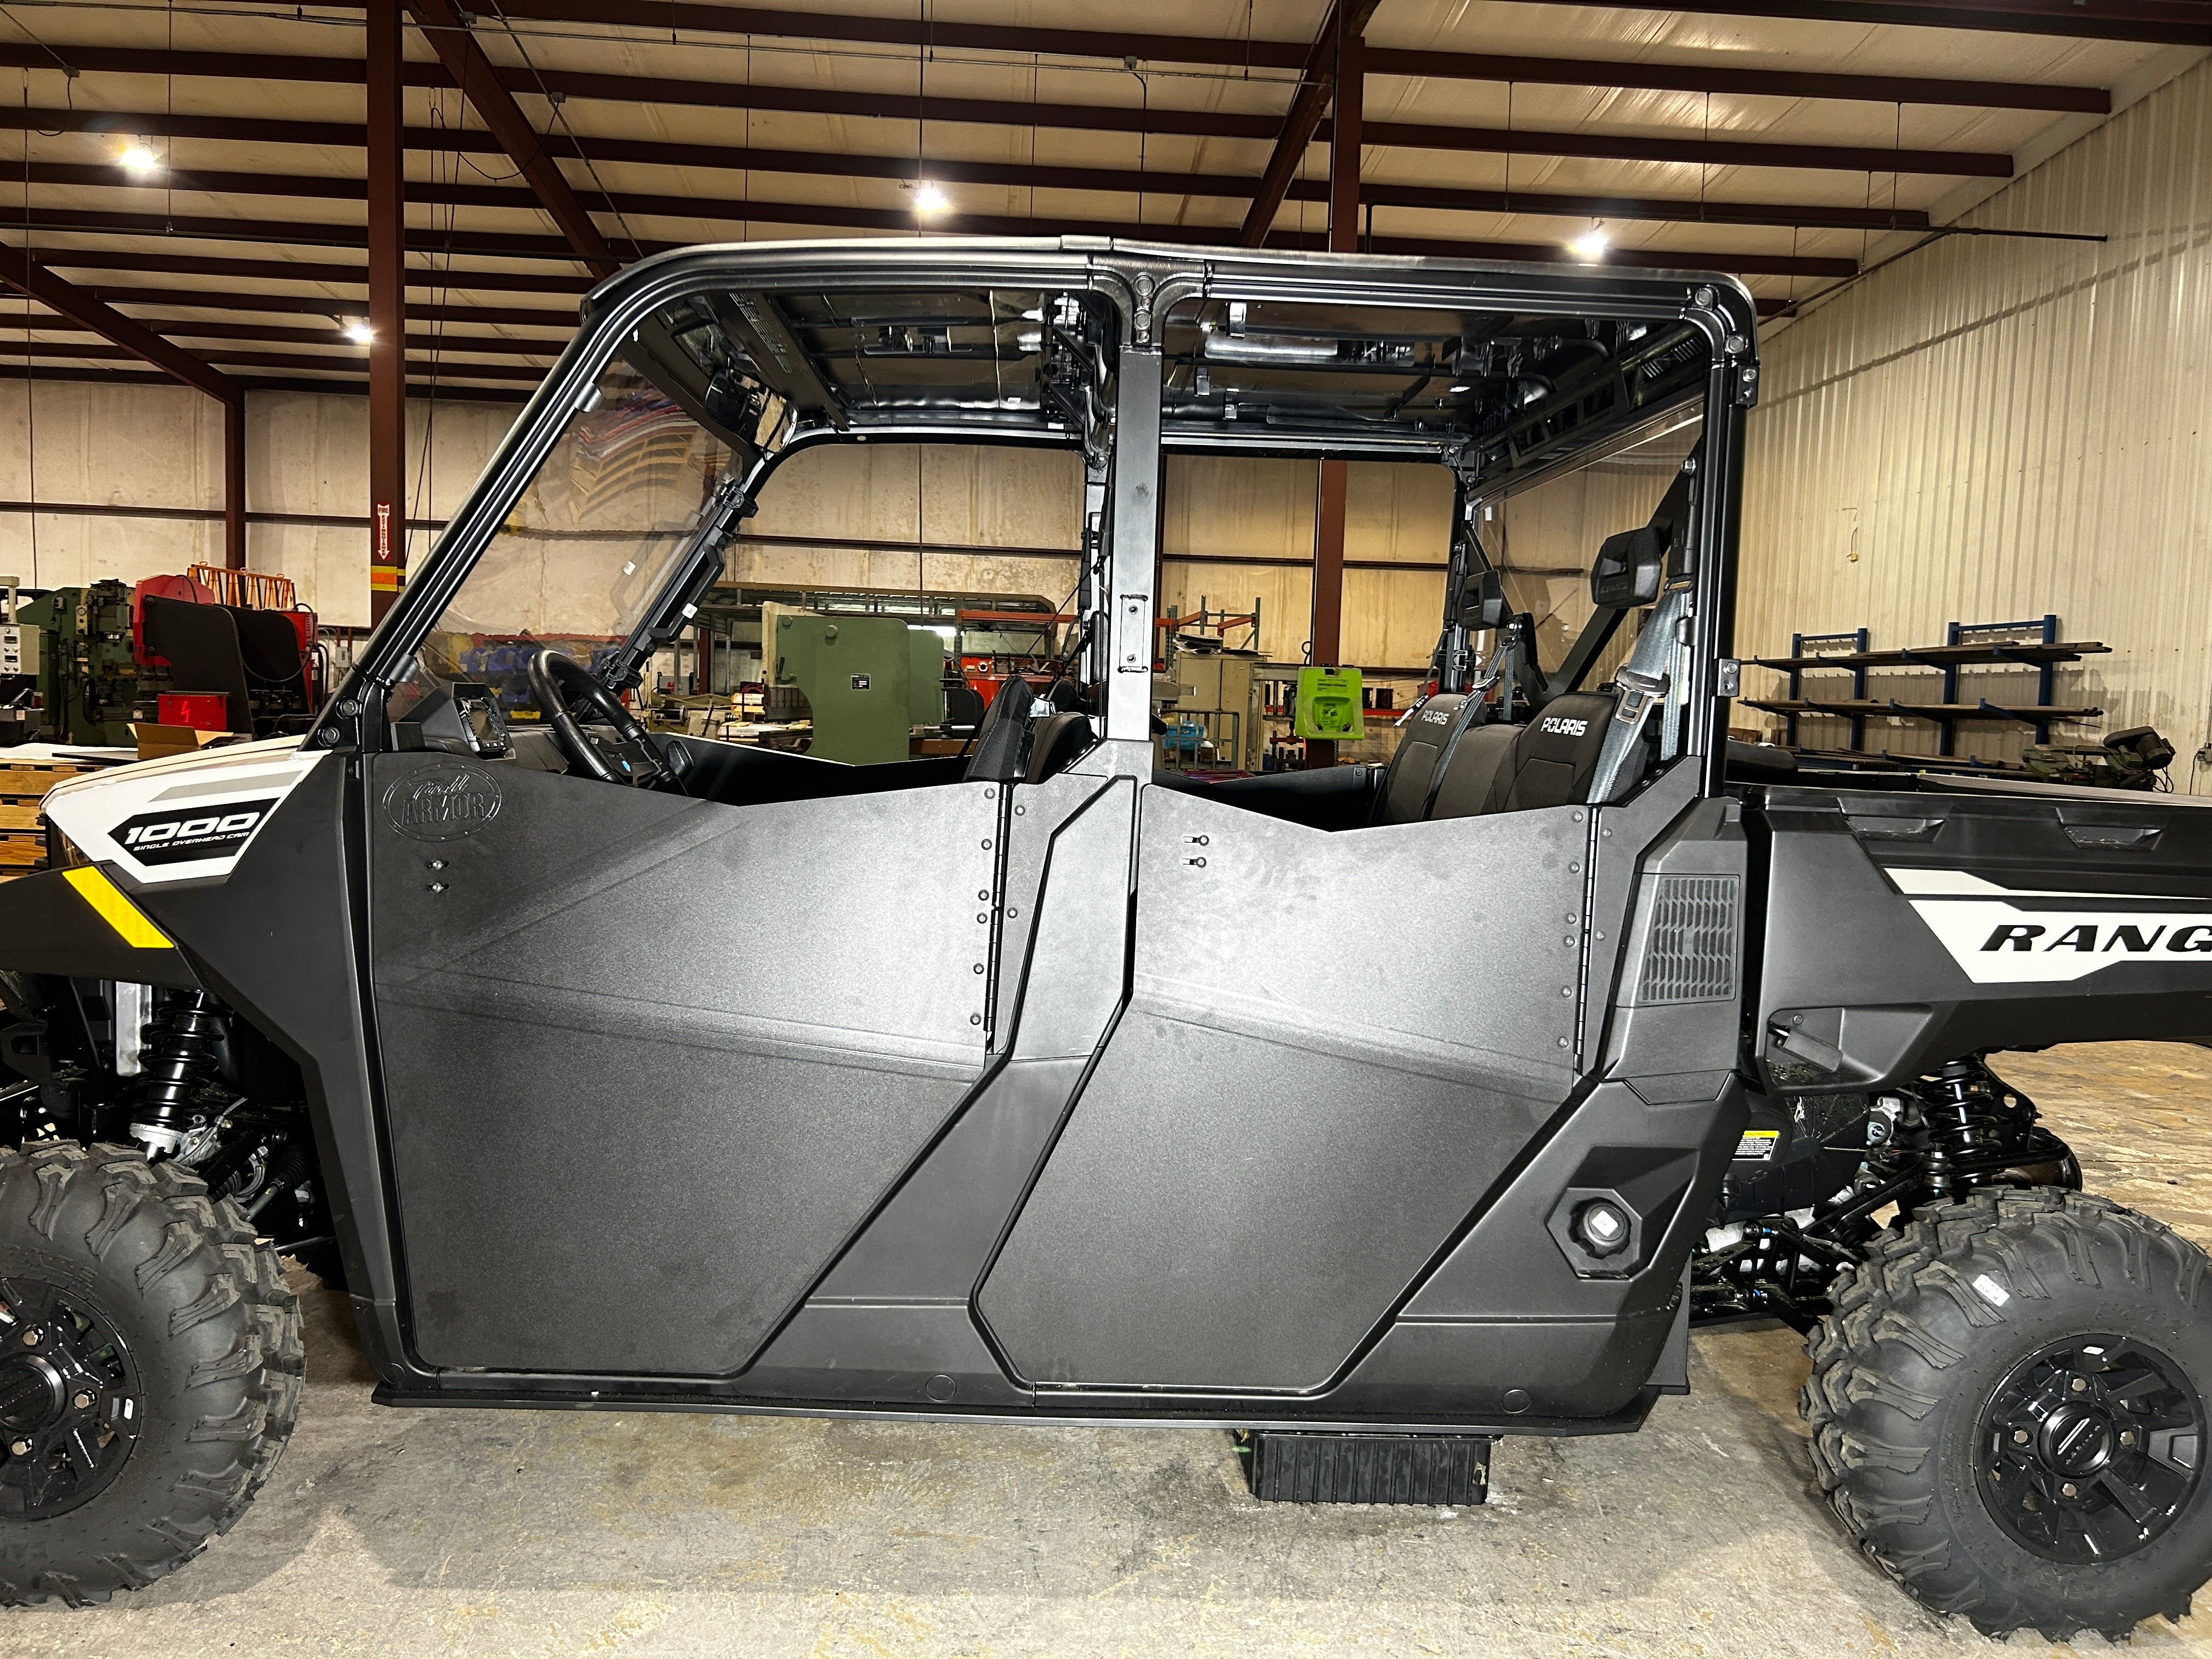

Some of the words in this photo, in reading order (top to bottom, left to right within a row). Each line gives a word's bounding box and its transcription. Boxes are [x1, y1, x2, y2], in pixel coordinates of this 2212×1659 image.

[1421, 710, 1449, 725] POLARIS
[1540, 717, 1589, 736] POLARIS
[402, 792, 485, 826] ARMOR
[124, 812, 260, 845] 1000
[133, 842, 170, 851] SINGLE
[172, 834, 225, 846] OVERHEAD
[226, 832, 250, 840] CAM
[1978, 924, 2212, 952] RANG
